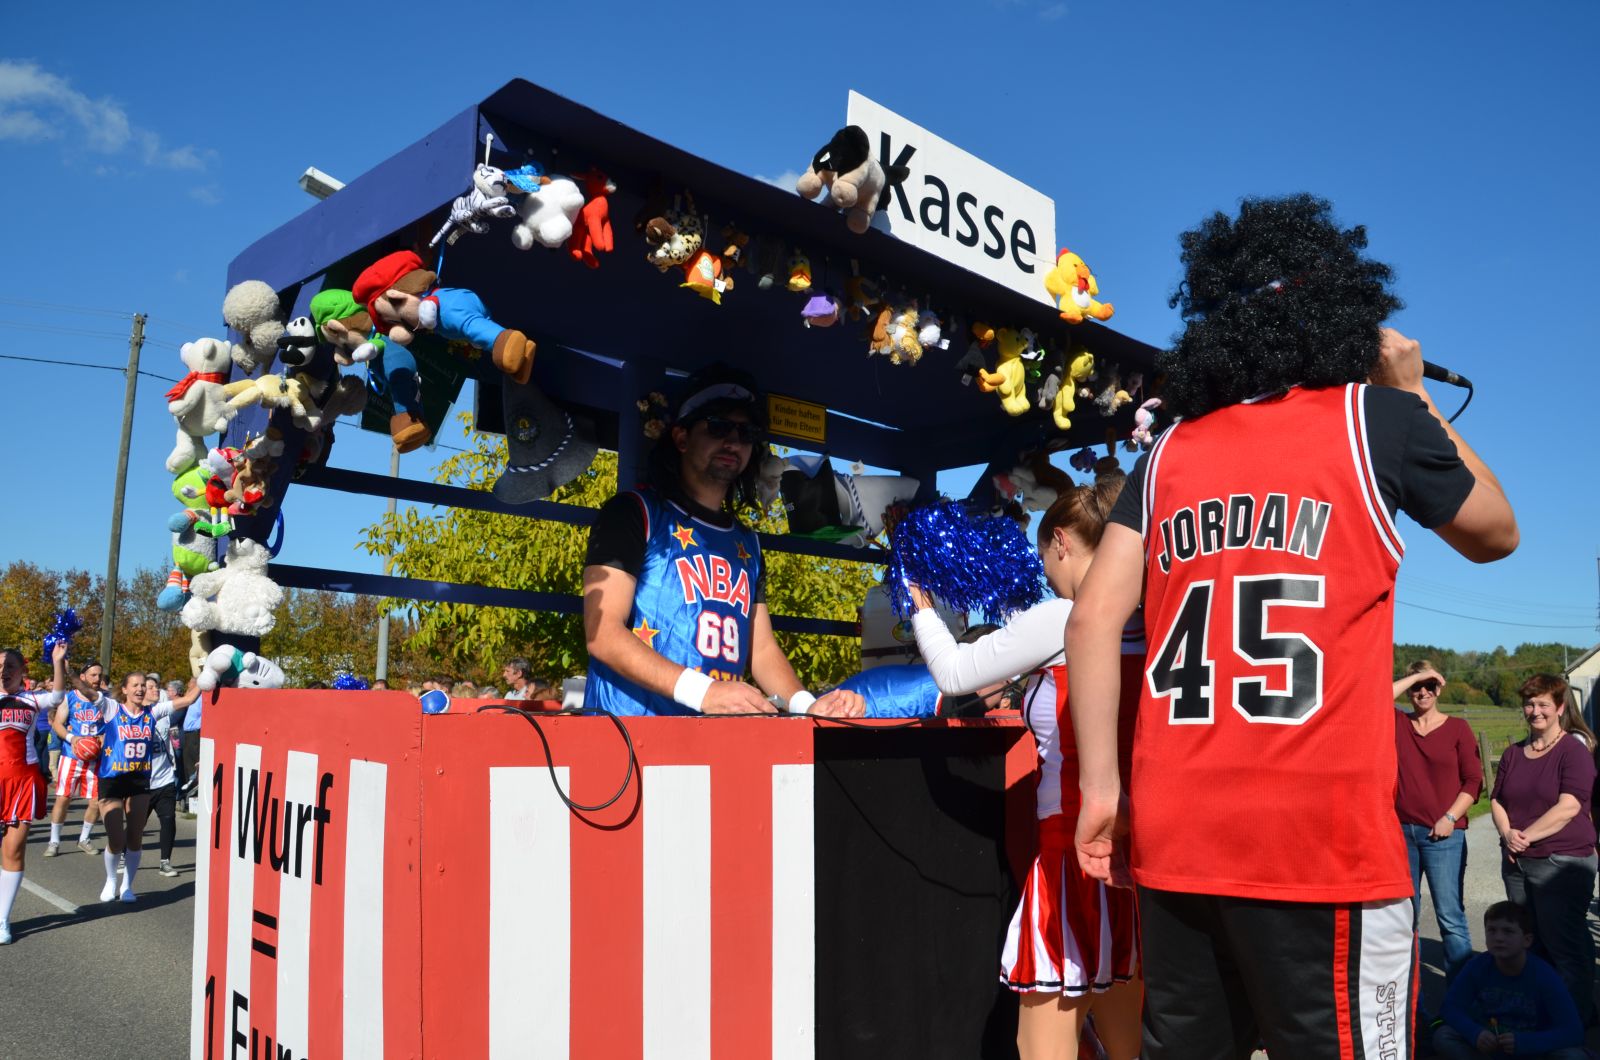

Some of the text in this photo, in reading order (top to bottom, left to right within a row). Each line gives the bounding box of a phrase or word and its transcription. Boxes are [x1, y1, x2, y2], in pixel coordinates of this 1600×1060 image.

[879, 131, 1037, 275] Kasse
[773, 415, 782, 425] für
[784, 418, 798, 429] Ihre
[775, 404, 820, 420] Kinder haften
[1158, 493, 1332, 575] JORDAN
[675, 554, 751, 619] NBA
[697, 609, 740, 664] 69
[1146, 573, 1325, 725] 45
[118, 725, 152, 741] NBA
[124, 742, 146, 759] 69
[111, 761, 151, 772] ALLST
[213, 763, 334, 886] 1 Wurf
[205, 975, 215, 1060] 1
